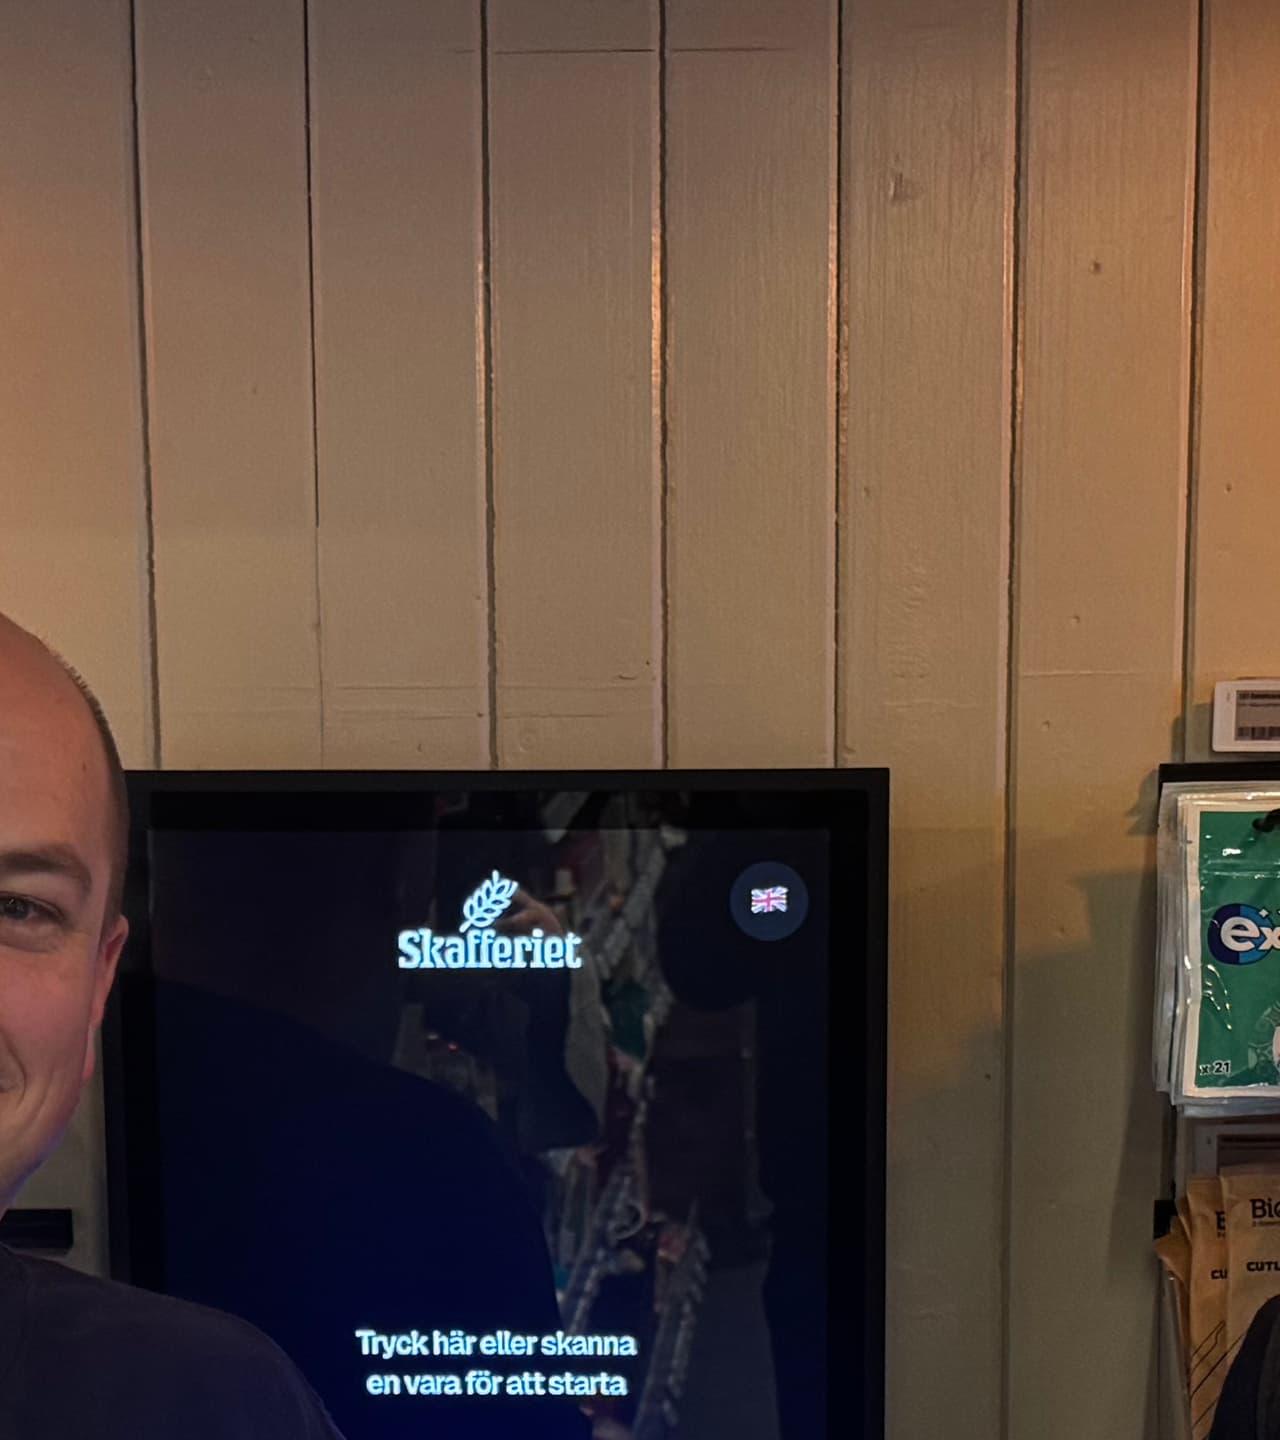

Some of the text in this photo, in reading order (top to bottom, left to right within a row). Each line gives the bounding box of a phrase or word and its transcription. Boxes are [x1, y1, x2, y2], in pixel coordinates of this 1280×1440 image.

[397, 927, 584, 969] Skafferiet
[1213, 1060, 1232, 1076] 21
[355, 1329, 639, 1359] Tryck här eller skanna
[366, 1371, 629, 1397] en vara för att starta
